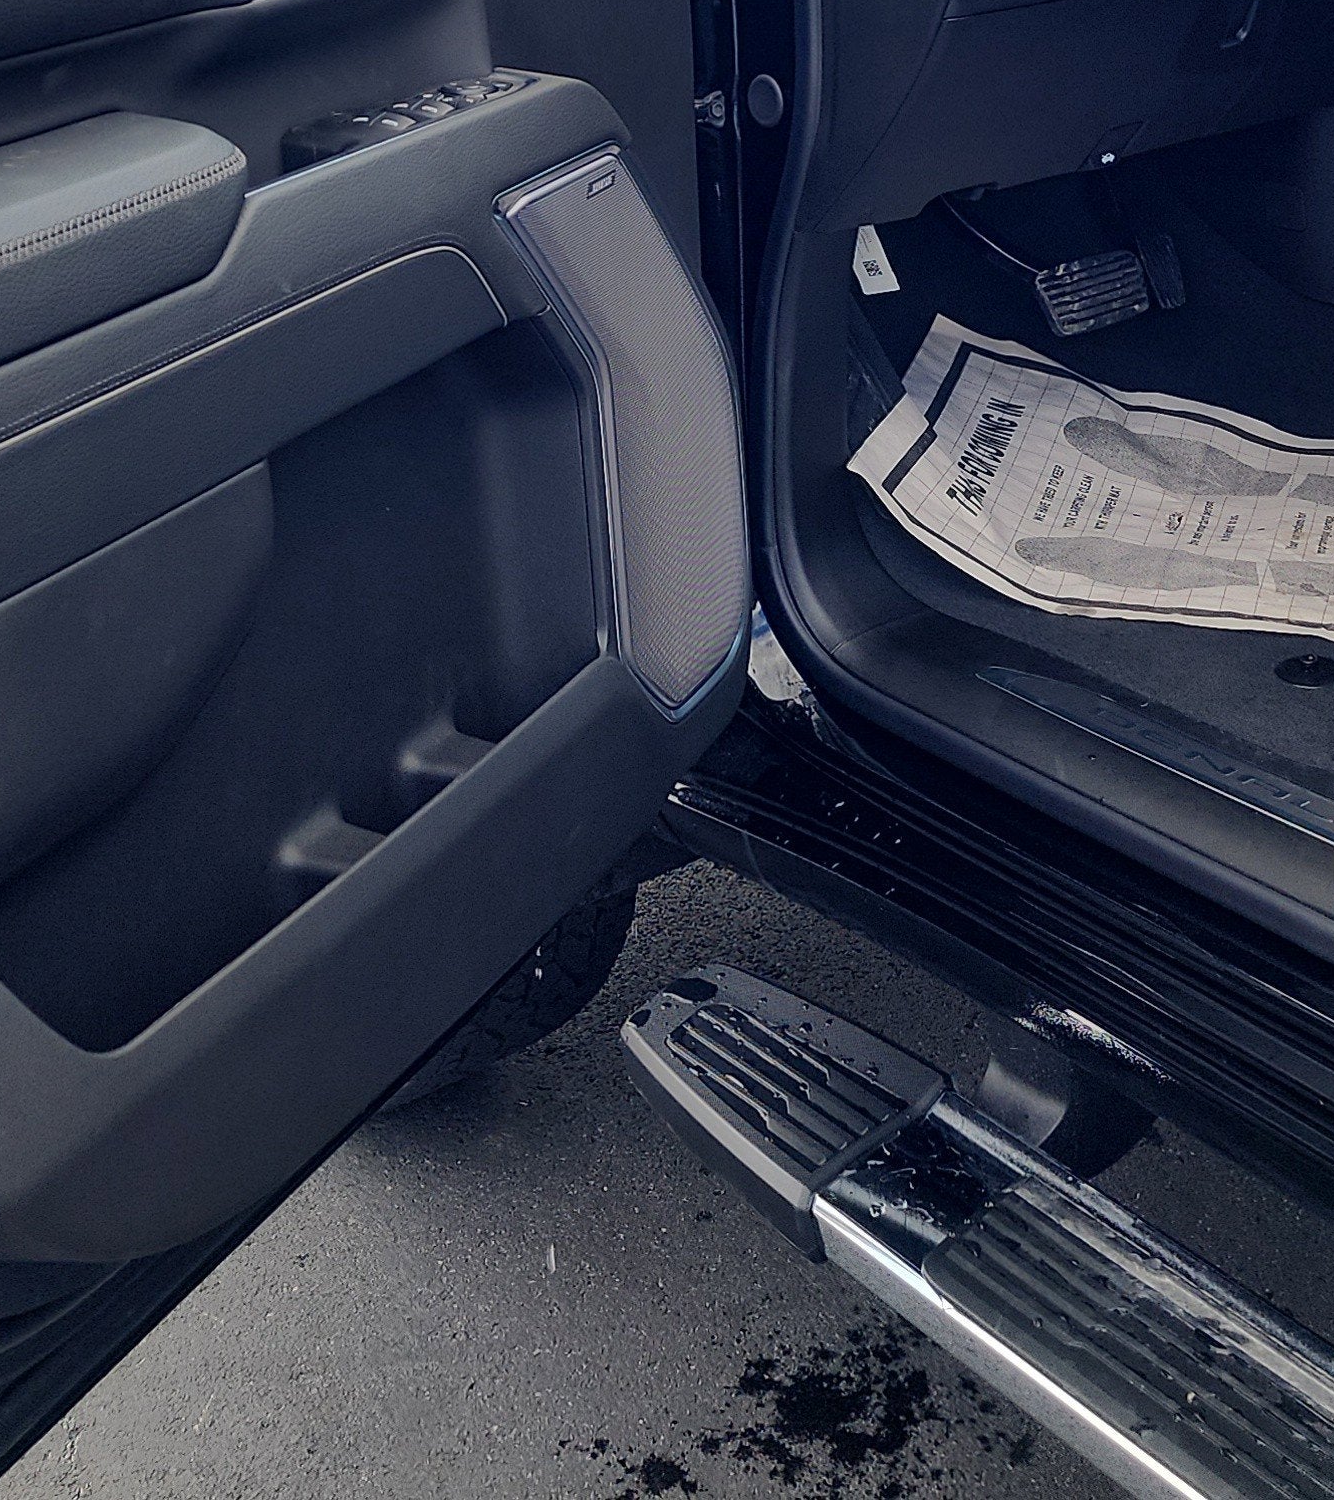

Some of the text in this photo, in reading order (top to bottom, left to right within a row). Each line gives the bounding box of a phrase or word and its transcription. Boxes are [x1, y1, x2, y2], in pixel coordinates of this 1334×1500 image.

[986, 397, 1026, 417] IN
[968, 413, 1019, 464] COMING
[1052, 464, 1065, 480] KEEP
